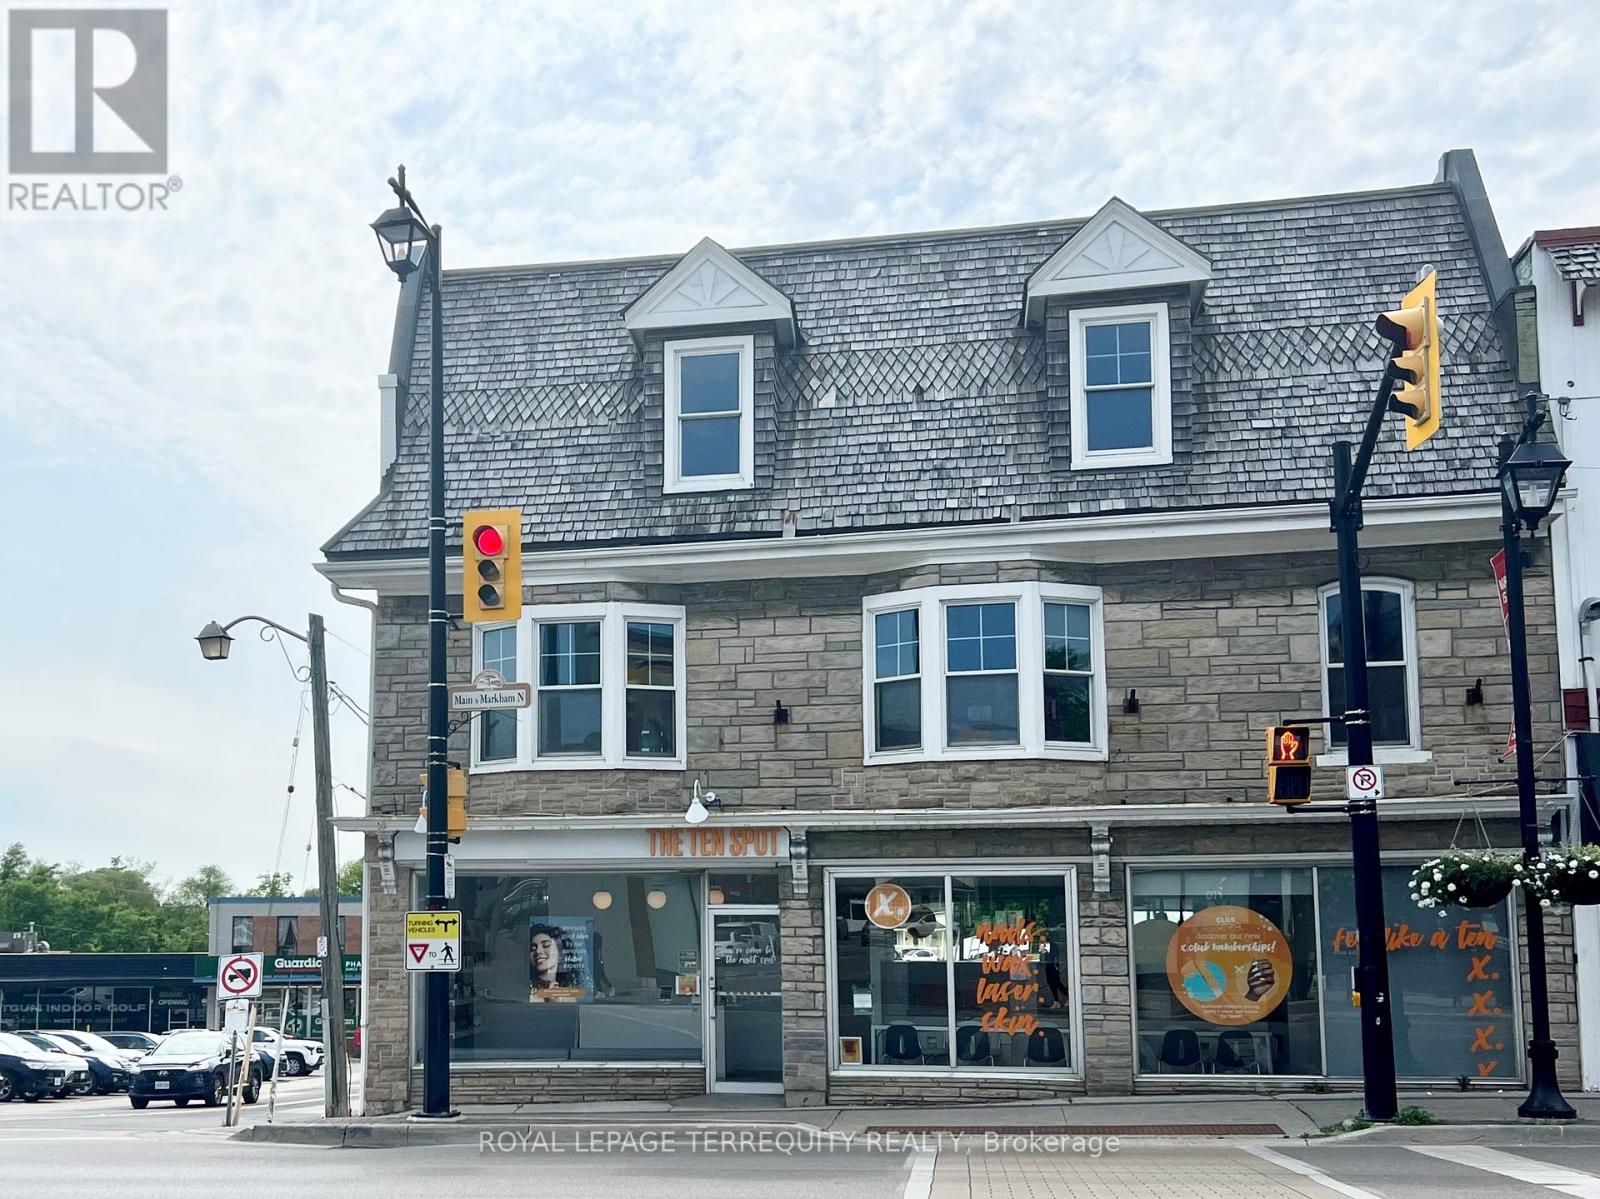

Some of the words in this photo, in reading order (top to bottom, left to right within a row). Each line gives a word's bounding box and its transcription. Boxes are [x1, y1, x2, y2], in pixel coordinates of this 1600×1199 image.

[454, 694, 473, 705] Main
[480, 692, 515, 705] Markham
[517, 691, 525, 703] N
[648, 828, 684, 857] THE
[688, 828, 725, 857] TEN
[729, 827, 781, 857] SPOT
[1430, 928, 1449, 950] a
[977, 978, 1045, 1004] laser.
[46, 1004, 102, 1012] INDOOR
[107, 1003, 147, 1012] GOLF
[980, 1006, 1045, 1037] skin.
